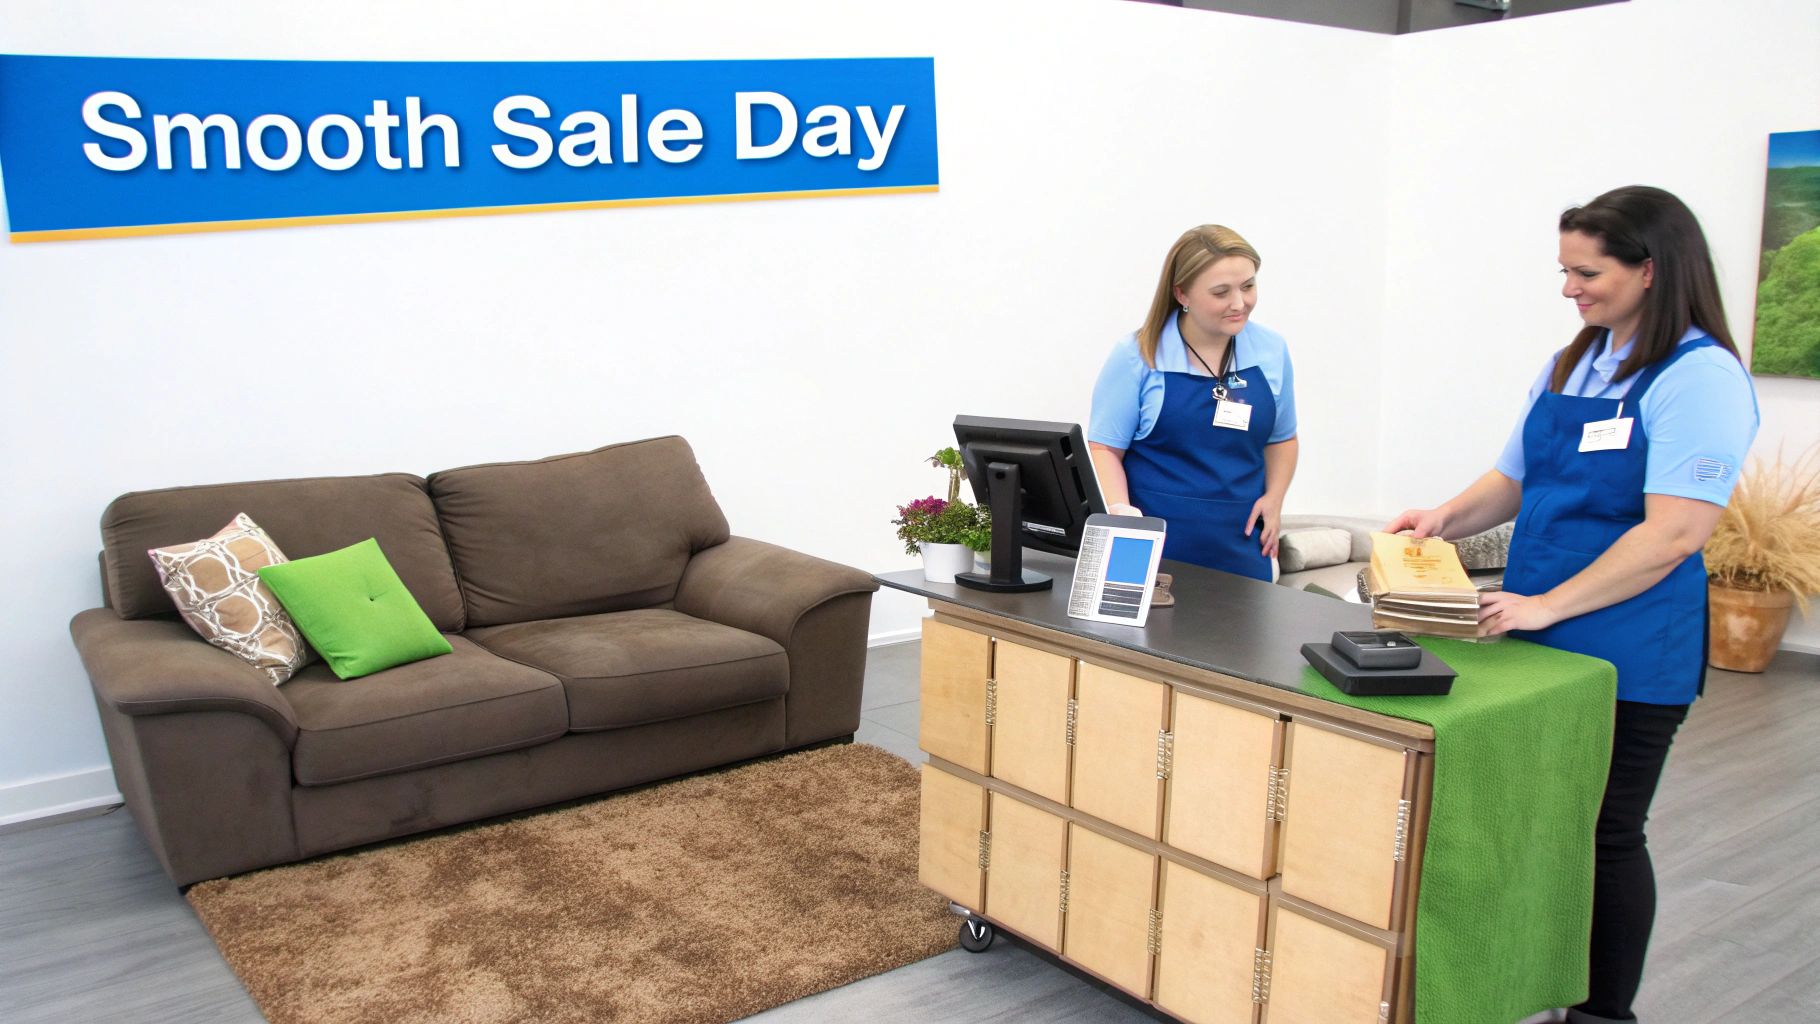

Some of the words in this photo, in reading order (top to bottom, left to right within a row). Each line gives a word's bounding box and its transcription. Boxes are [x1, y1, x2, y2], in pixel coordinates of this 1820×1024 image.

[82, 91, 461, 171] Smooth
[491, 93, 704, 170] Sale
[735, 91, 906, 171] Day
